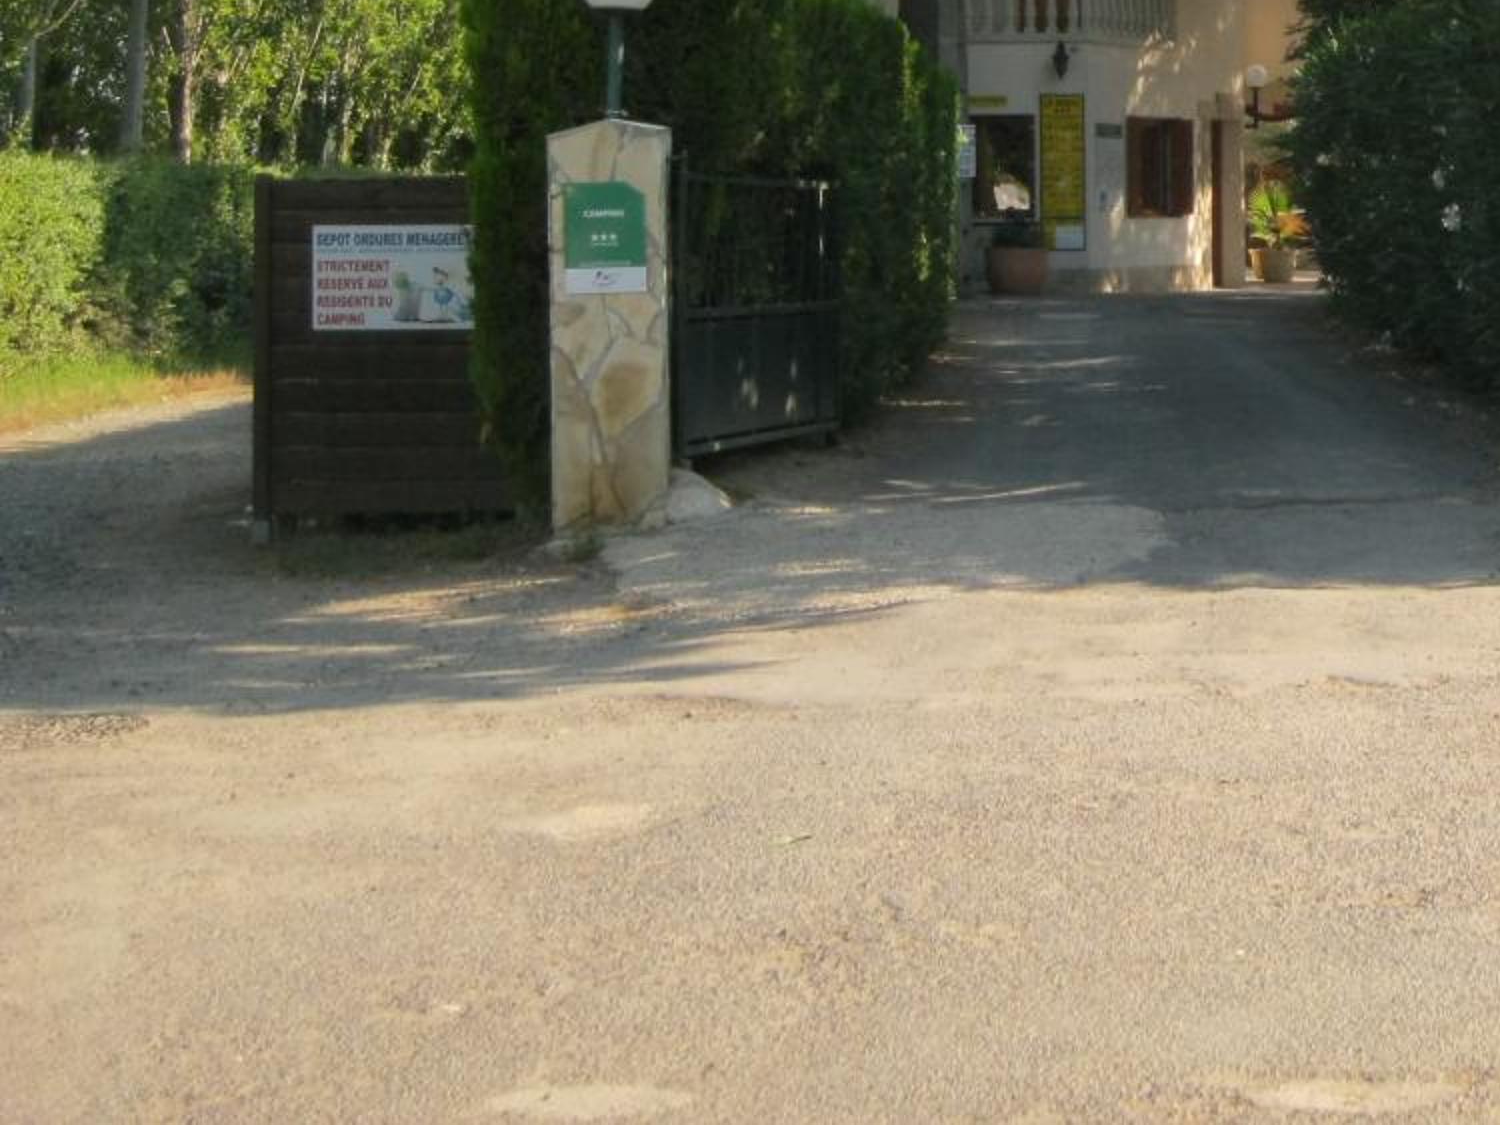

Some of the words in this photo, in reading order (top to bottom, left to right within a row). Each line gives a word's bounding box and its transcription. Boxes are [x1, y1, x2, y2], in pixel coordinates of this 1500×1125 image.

[317, 233, 350, 246] DEPOT
[354, 233, 402, 246] ORDURES
[318, 260, 389, 273] STRICTEMENT
[318, 313, 365, 325] CAMPING
